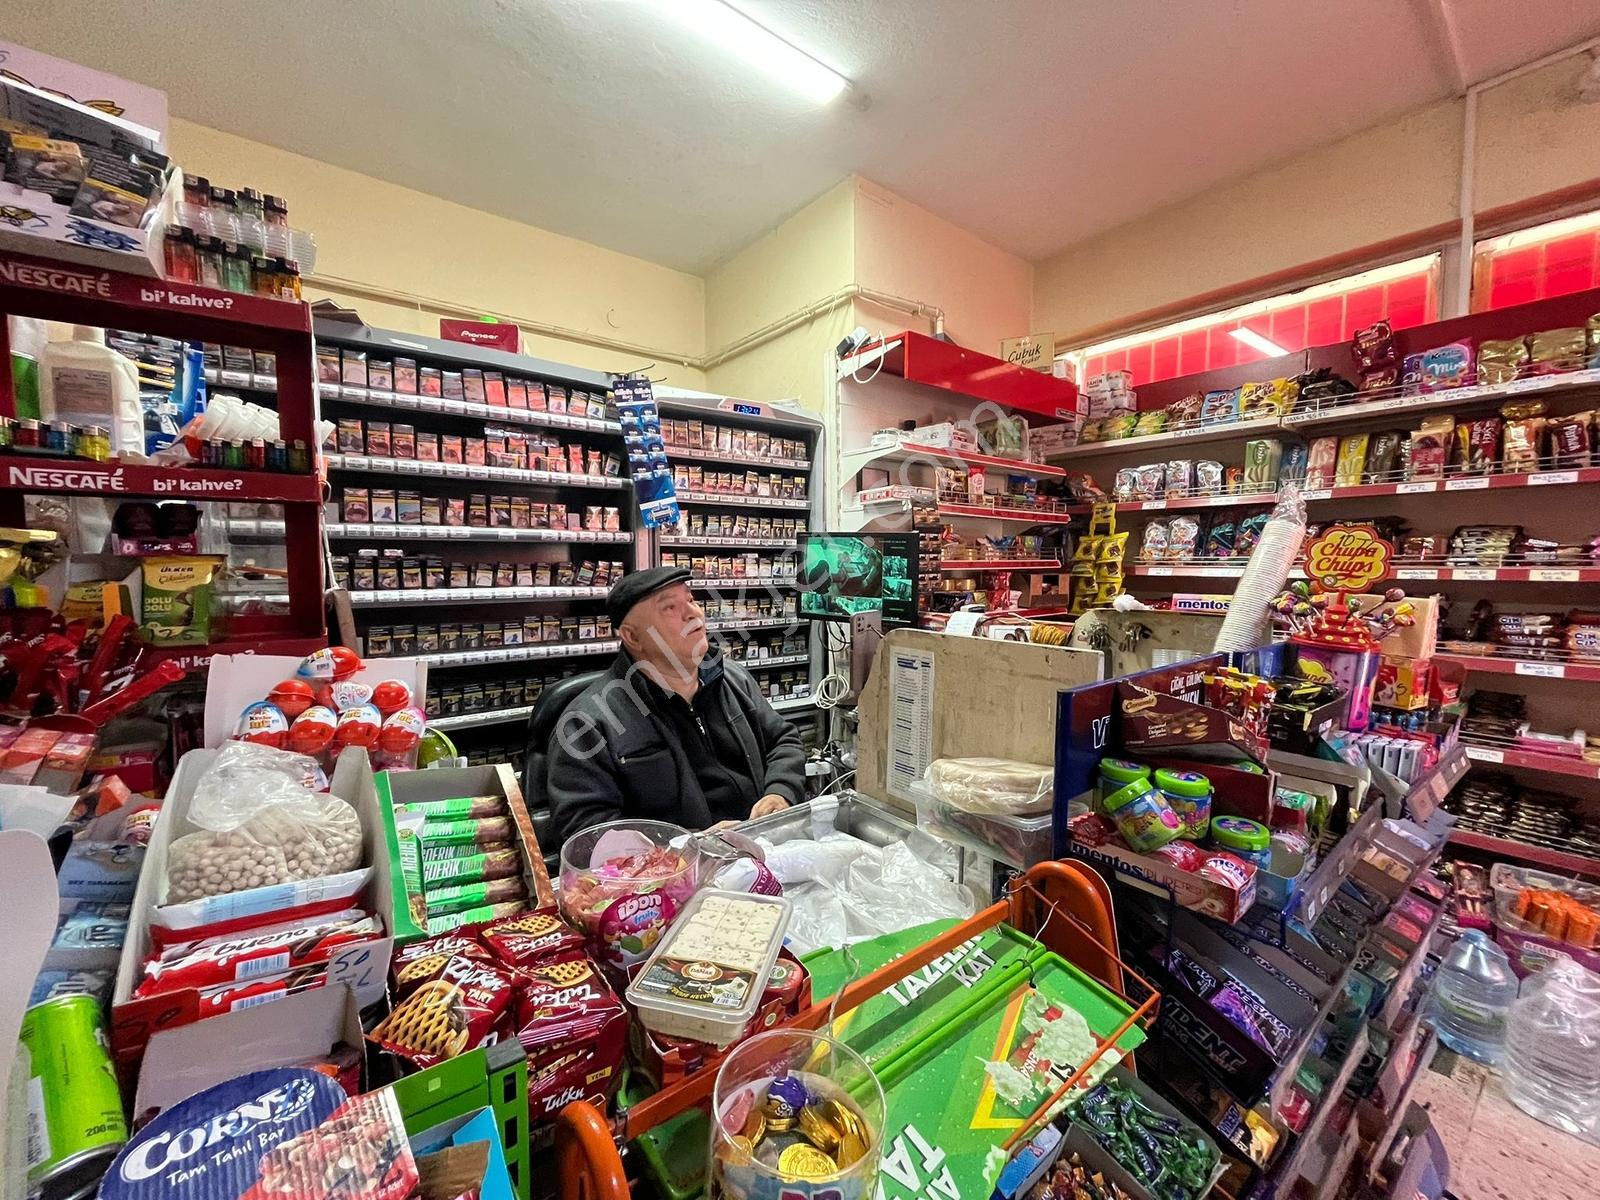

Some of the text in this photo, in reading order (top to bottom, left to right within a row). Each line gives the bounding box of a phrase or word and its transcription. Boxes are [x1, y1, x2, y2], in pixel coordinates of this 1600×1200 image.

[0, 264, 111, 298] NESCAFÉ
[168, 291, 234, 310] kahve?
[9, 467, 125, 491] NESCAFÉ
[180, 478, 243, 491] kahve?
[1320, 542, 1379, 560] Chupa
[1316, 557, 1373, 580] Chups
[1177, 600, 1230, 610] mentos
[1073, 842, 1145, 877] mentos
[617, 895, 662, 920] ibon
[212, 927, 310, 958] bueno
[951, 947, 997, 989] KAT
[466, 987, 495, 1005] TART
[541, 1085, 585, 1113] Tutku
[166, 1126, 285, 1187] Tam Tahıl Bar
